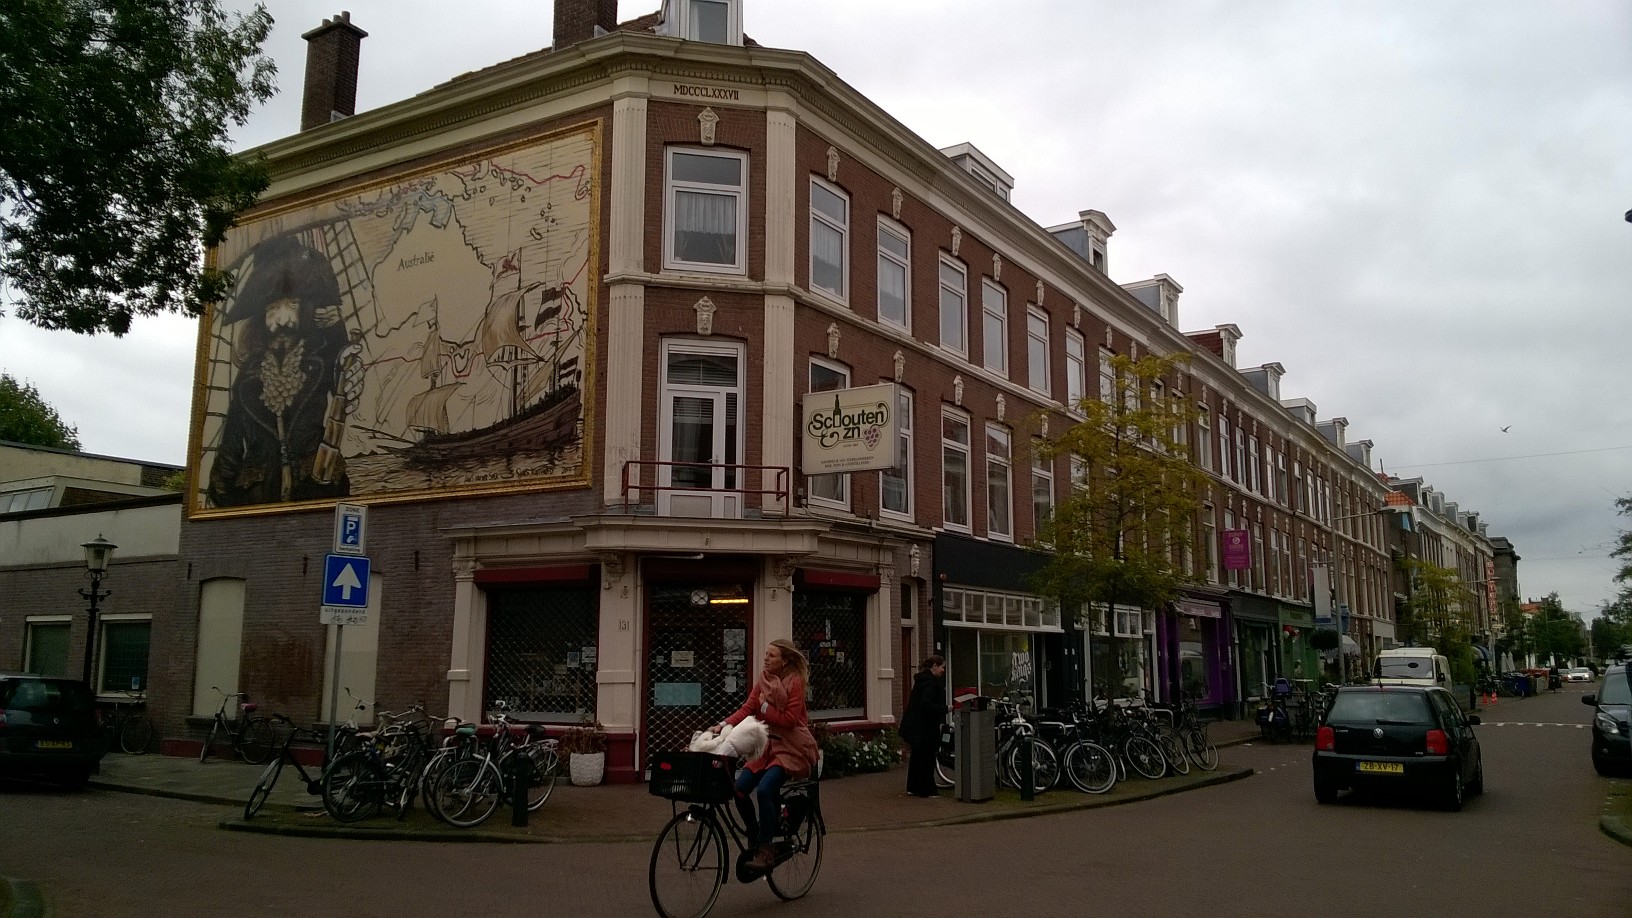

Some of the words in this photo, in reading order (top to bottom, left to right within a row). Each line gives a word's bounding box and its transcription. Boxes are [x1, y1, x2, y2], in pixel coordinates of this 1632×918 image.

[673, 84, 739, 100] MDCCCLXXXVII
[397, 252, 435, 271] Australië
[346, 521, 356, 535] P
